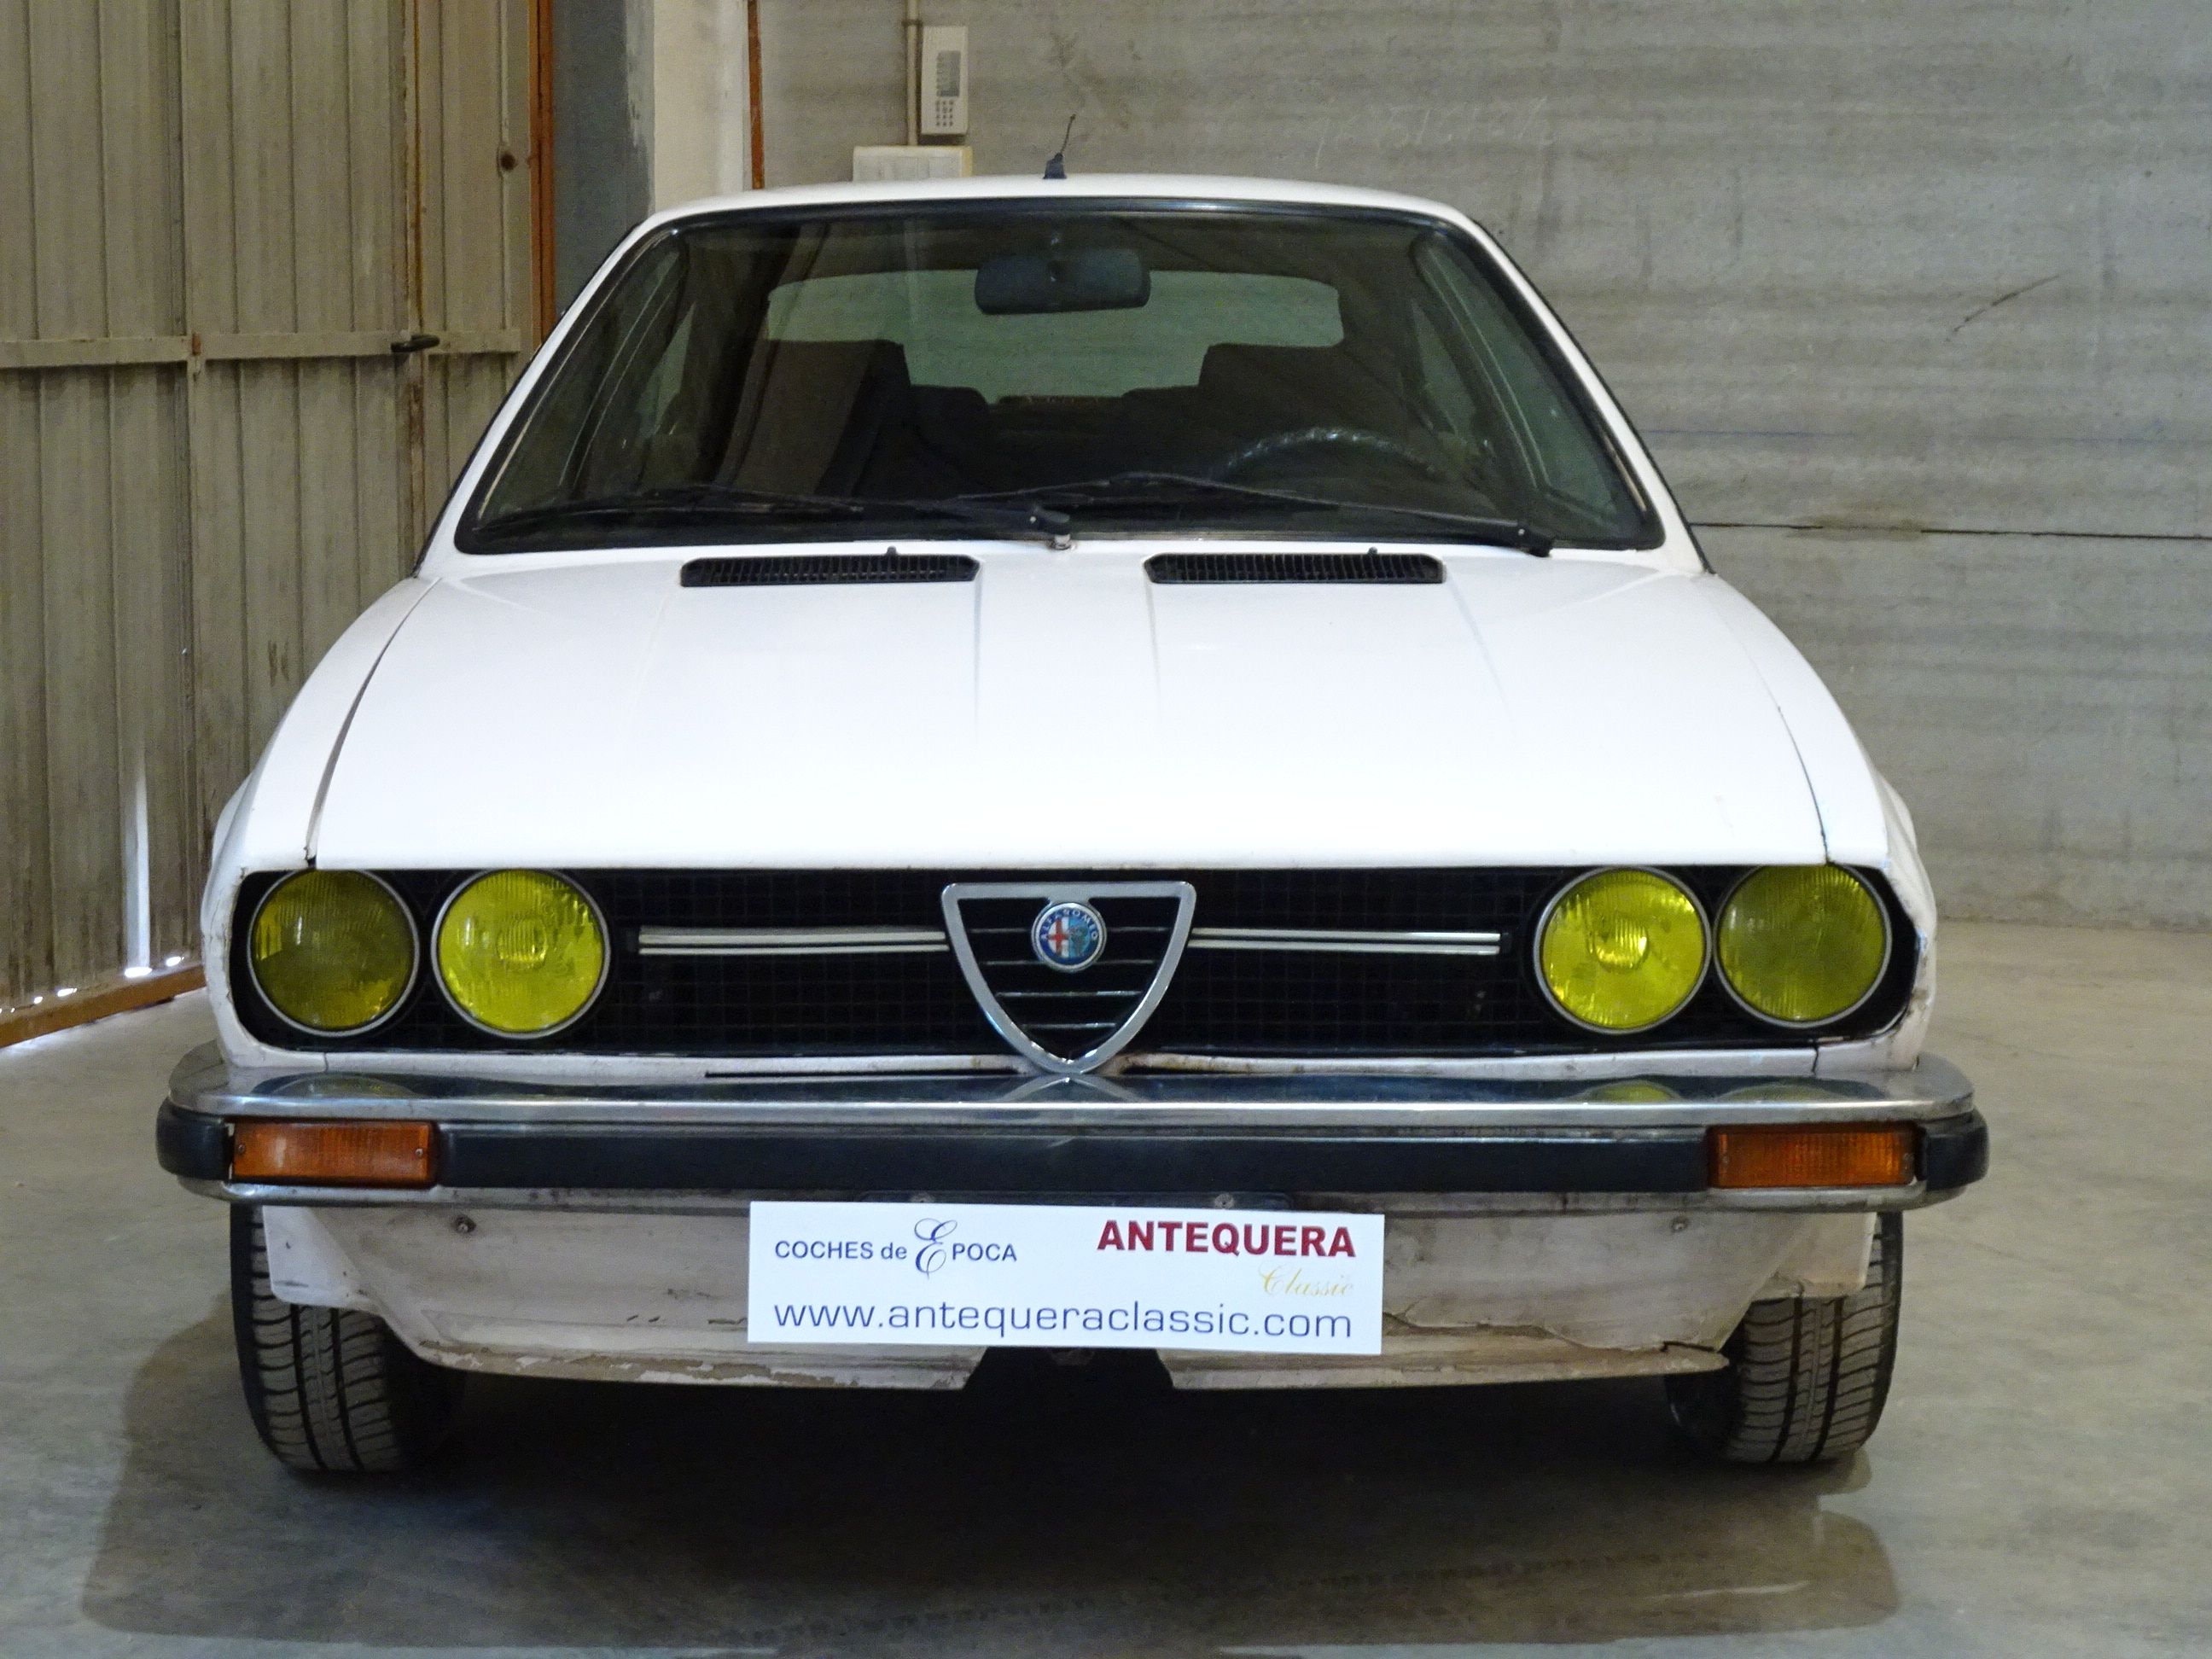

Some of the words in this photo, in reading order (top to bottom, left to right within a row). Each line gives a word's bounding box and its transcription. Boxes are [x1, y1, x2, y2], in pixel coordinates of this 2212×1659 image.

[1062, 909, 1098, 940] ROMEO
[775, 1241, 874, 1260] COCHES
[880, 1242, 908, 1260] de
[1097, 1219, 1357, 1258] ANTEQUERA
[1258, 1263, 1353, 1295] Classic
[775, 1301, 1351, 1337] www.antequeraclassic.com
